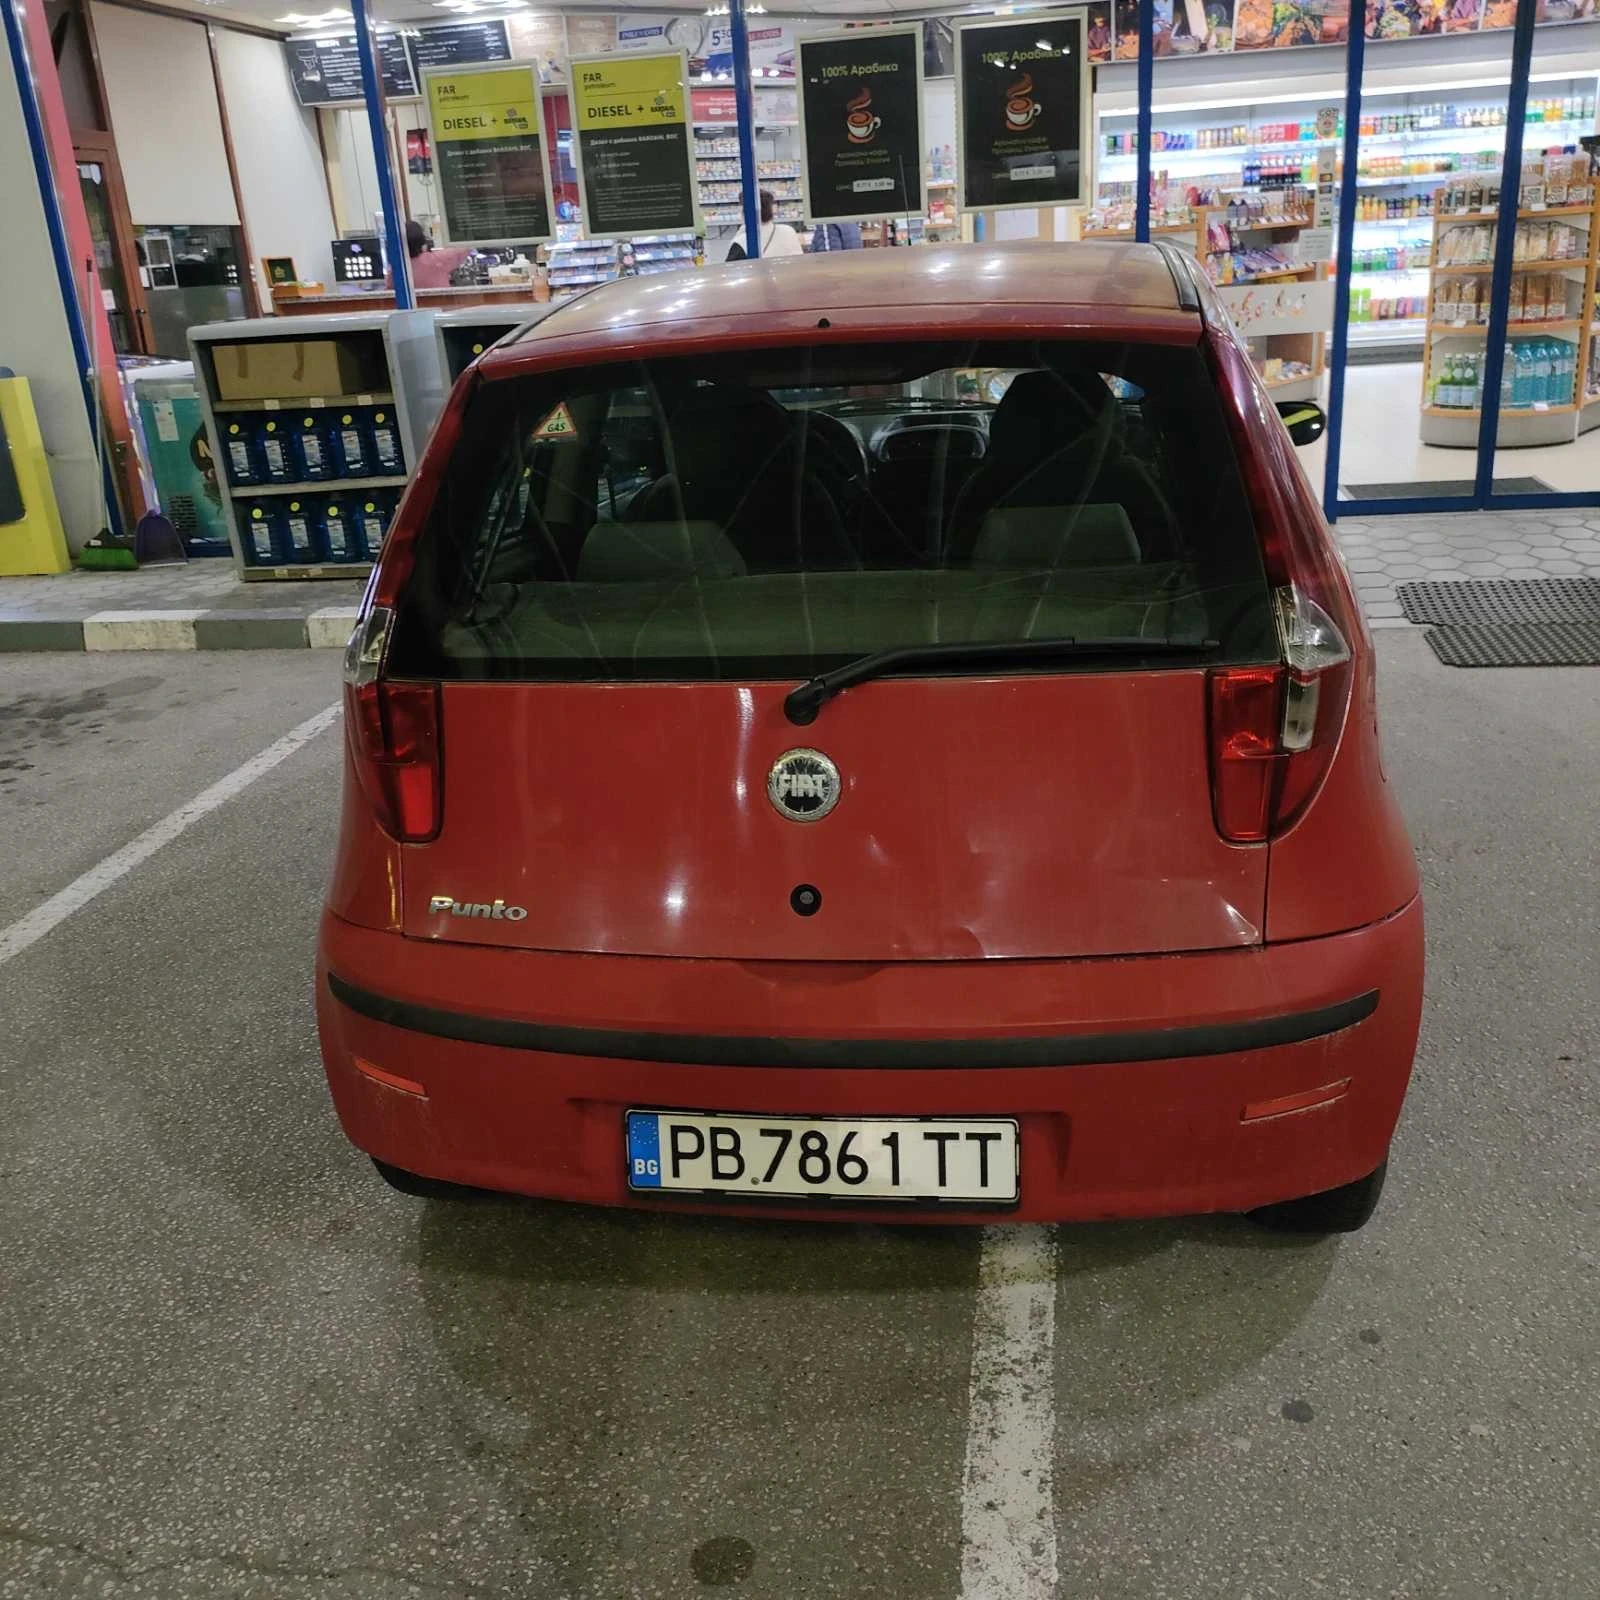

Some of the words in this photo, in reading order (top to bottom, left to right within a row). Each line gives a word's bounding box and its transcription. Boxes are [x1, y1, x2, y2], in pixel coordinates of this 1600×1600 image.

[822, 65, 849, 78] 100%
[851, 62, 898, 77] Арабика
[583, 73, 602, 83] FAR
[437, 85, 456, 95] FAR
[587, 104, 633, 119] DIESEL
[443, 116, 488, 130] DIESEL
[547, 423, 566, 432] GAS
[779, 774, 827, 798] FIAT
[429, 896, 528, 921] Punto
[669, 1124, 746, 1181] PB
[759, 1128, 900, 1187] 7861
[923, 1131, 1002, 1188] TT
[634, 1158, 659, 1176] BG
